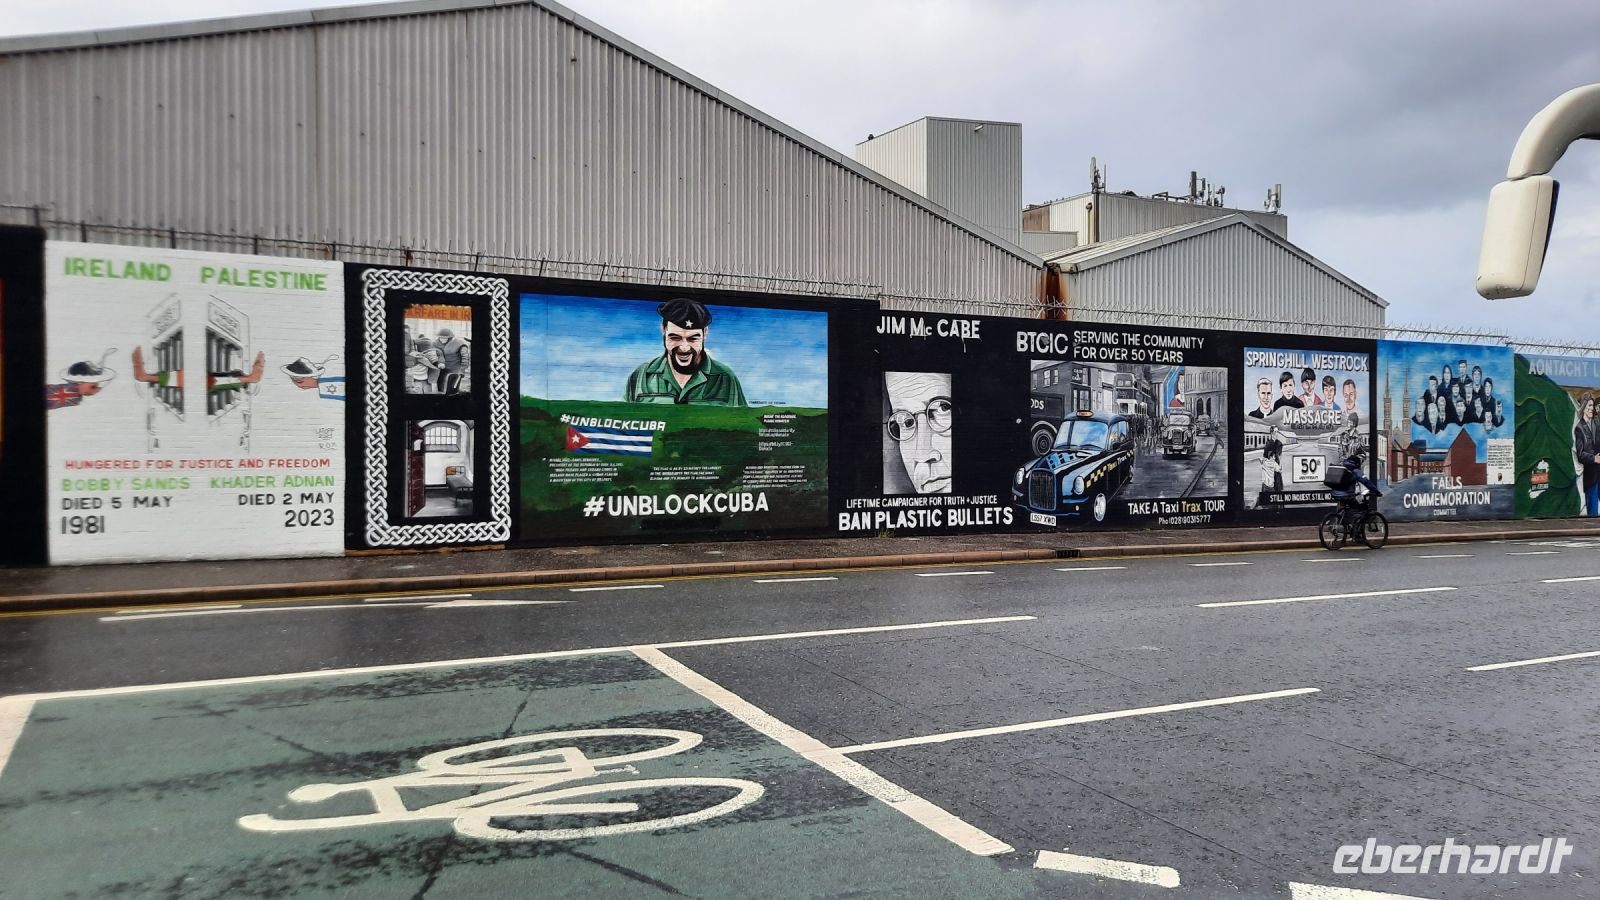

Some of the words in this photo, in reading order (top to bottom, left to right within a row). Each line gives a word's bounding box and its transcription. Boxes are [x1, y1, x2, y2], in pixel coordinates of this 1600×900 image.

[65, 257, 171, 281] IRELAND
[201, 266, 328, 291] PALESTINE
[877, 316, 905, 334] JIM
[910, 317, 932, 337] Mc
[937, 319, 981, 338] CABE
[1016, 331, 1068, 354] BTCIC
[1073, 330, 1118, 345] SERVING
[1122, 333, 1141, 346] THE
[1143, 335, 1204, 349] COMMUNITY
[1073, 347, 1097, 359] FOR
[1100, 348, 1128, 361] OVER
[1131, 349, 1145, 362] 50
[1148, 350, 1184, 363] YEARS
[1246, 351, 1308, 369] SPRINGHILL
[1312, 353, 1369, 371] WESTROCK
[1528, 358, 1589, 377] AONTACHT
[560, 413, 666, 432] #UNBLOCKCUBA
[1283, 409, 1342, 425] MASSACRE
[64, 459, 141, 470] HUNGERED
[146, 459, 174, 469] FOR
[179, 459, 233, 469] JUSTICE
[238, 458, 264, 468] AND
[269, 458, 330, 468] FREEDOM
[61, 478, 125, 491] BOBBY
[131, 477, 191, 490] SANDS
[210, 476, 275, 488] KHADER
[283, 475, 335, 487] ADNAN
[1432, 476, 1462, 490] FALLS
[62, 497, 103, 510] DIED
[111, 496, 122, 509] 5
[133, 496, 173, 508] MAY
[238, 494, 275, 506] DIED
[283, 493, 293, 505] 2
[300, 492, 335, 505] MAY
[583, 492, 769, 517] #UNBLOCKCUBA
[847, 498, 880, 509] LIFETIME
[882, 497, 928, 508] CAMPAIGNER
[929, 496, 942, 506] FOR
[943, 496, 965, 506] TRUTH
[970, 495, 997, 505] JUSTICE
[1127, 502, 1150, 515] TAKE
[1152, 502, 1159, 513] A
[1160, 501, 1179, 513] Taxi
[1181, 500, 1201, 513] Trax
[1203, 499, 1225, 511] TOUR
[1403, 491, 1491, 508] COMMEMORATION
[61, 515, 105, 534] 1981
[285, 509, 334, 528] 2023
[838, 511, 871, 531] BAN
[875, 509, 942, 529] PLASTIC
[948, 506, 1013, 526] BULLETS
